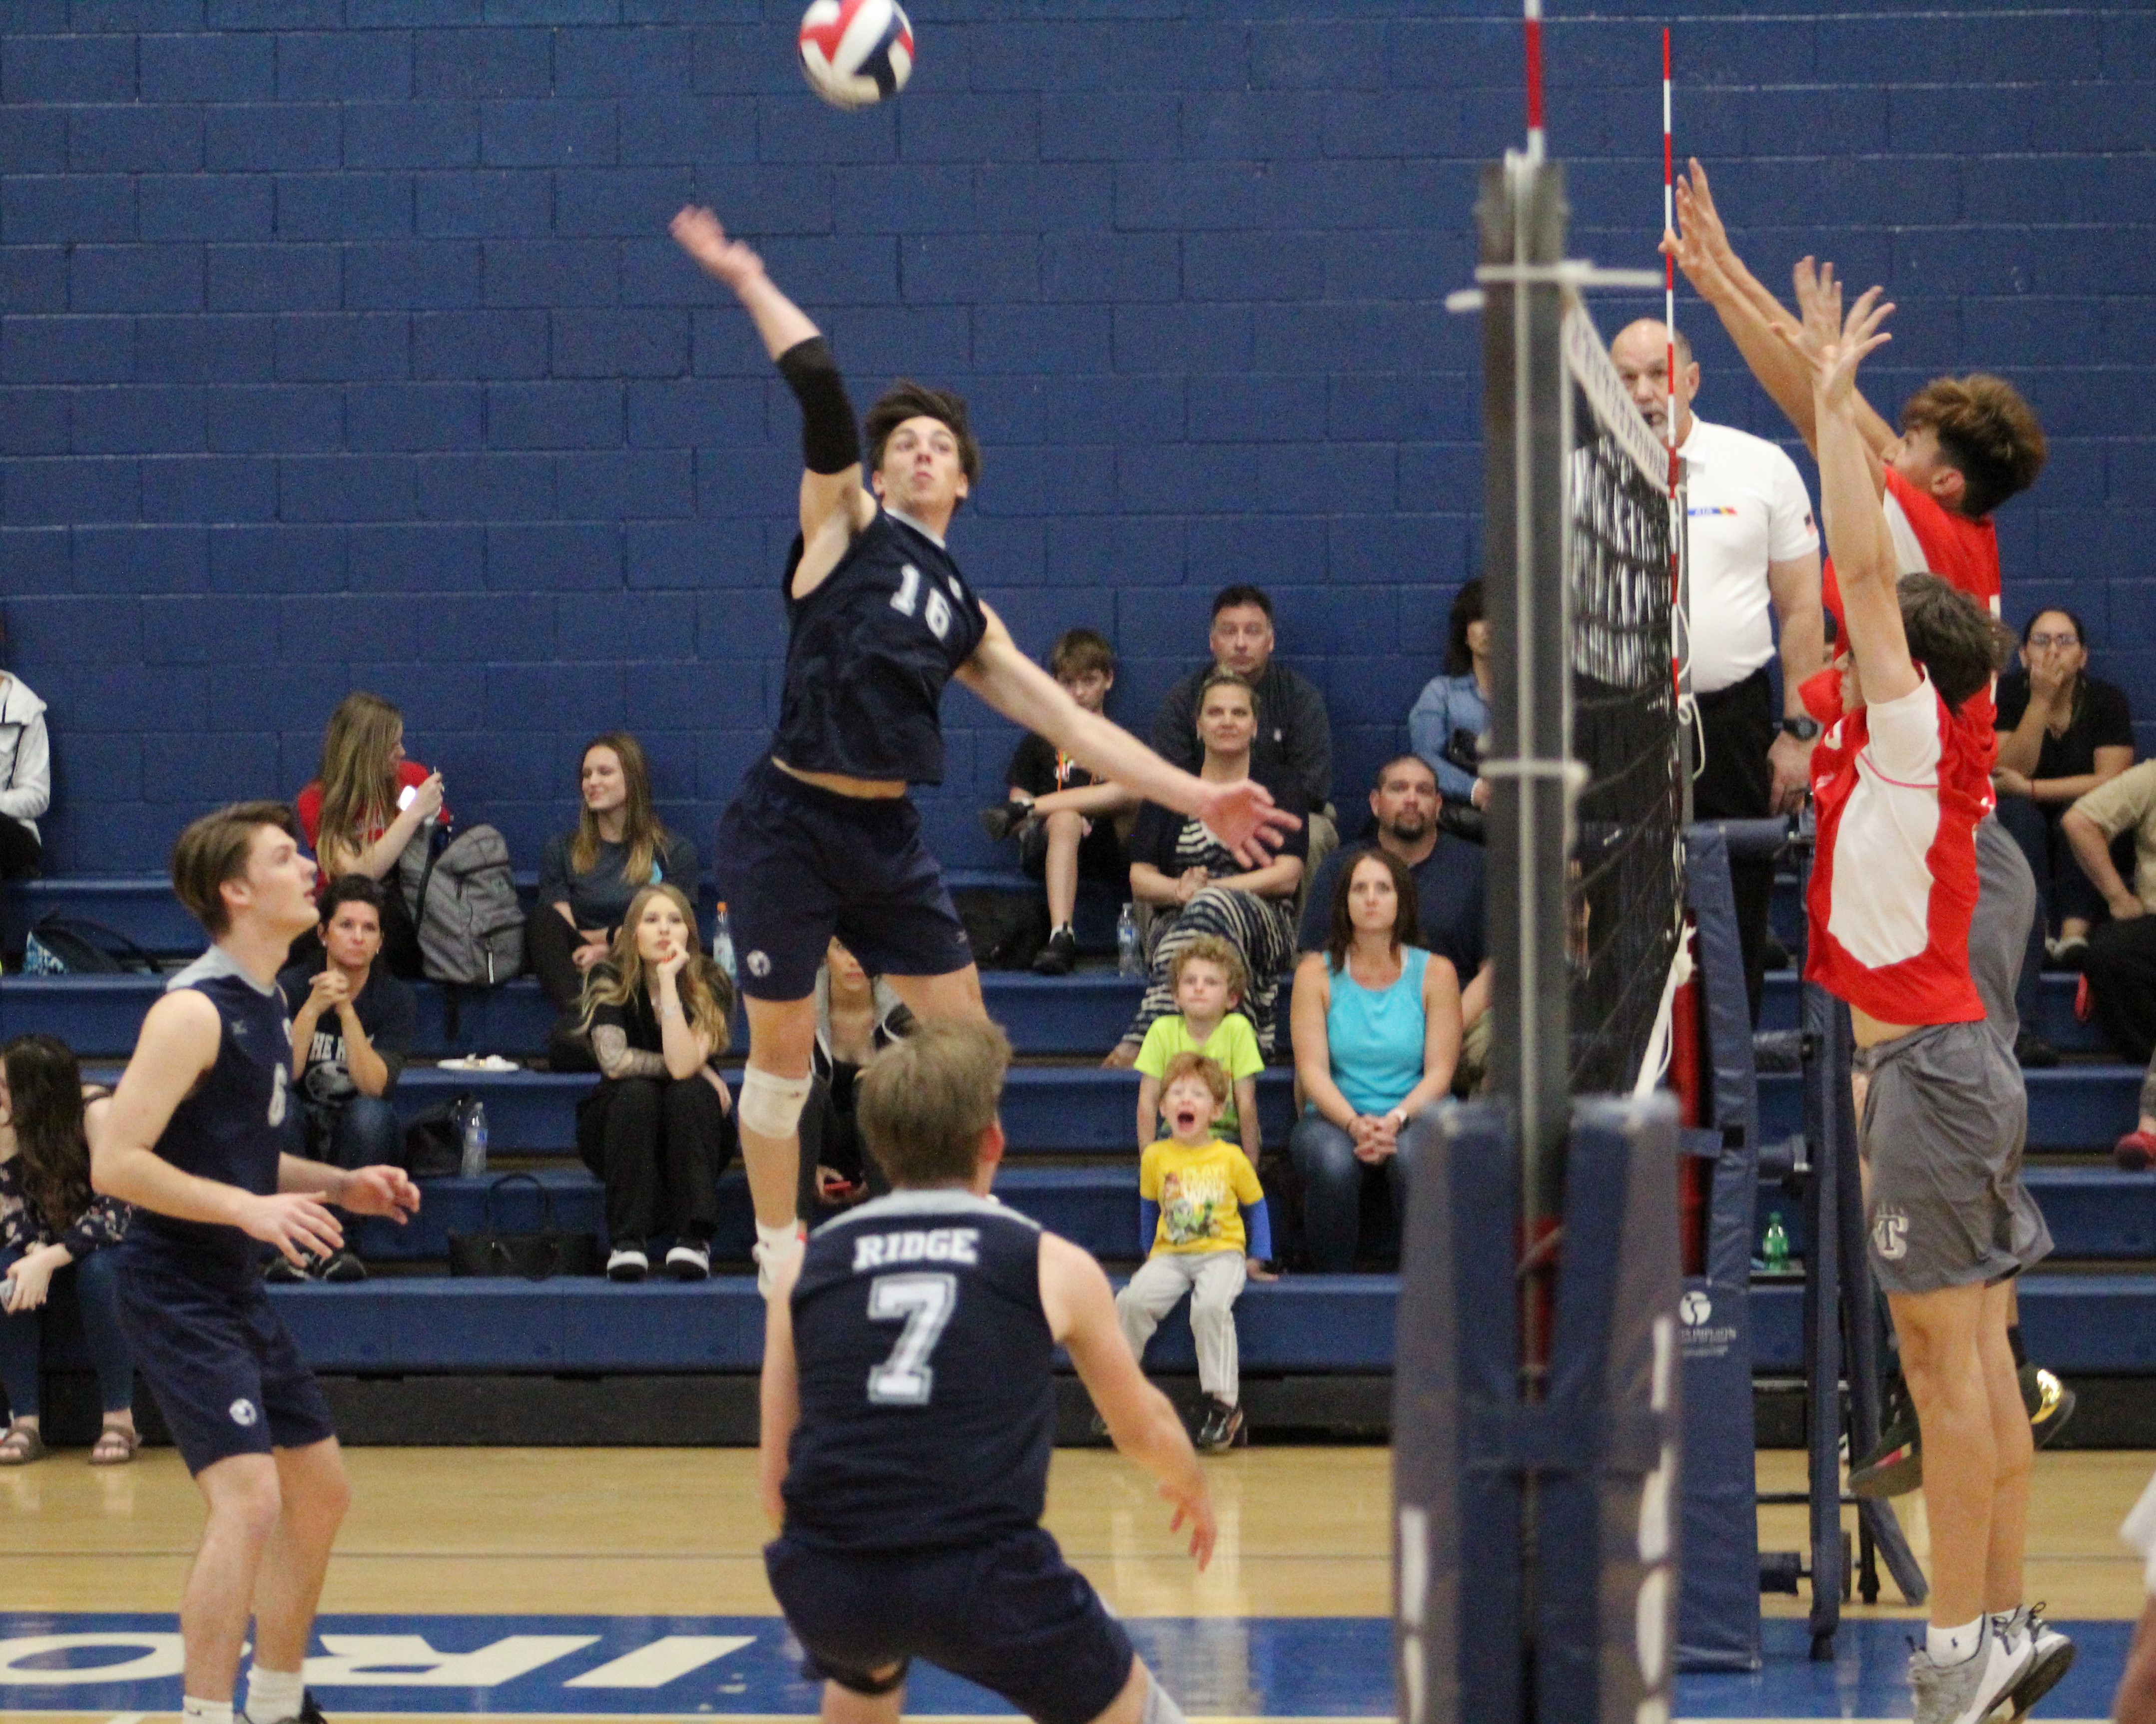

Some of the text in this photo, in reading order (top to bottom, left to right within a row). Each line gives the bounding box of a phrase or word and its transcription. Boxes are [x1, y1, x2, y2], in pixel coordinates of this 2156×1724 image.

[890, 564, 951, 641] 16
[852, 1227, 979, 1273] RIDGE
[867, 1273, 959, 1406] 7
